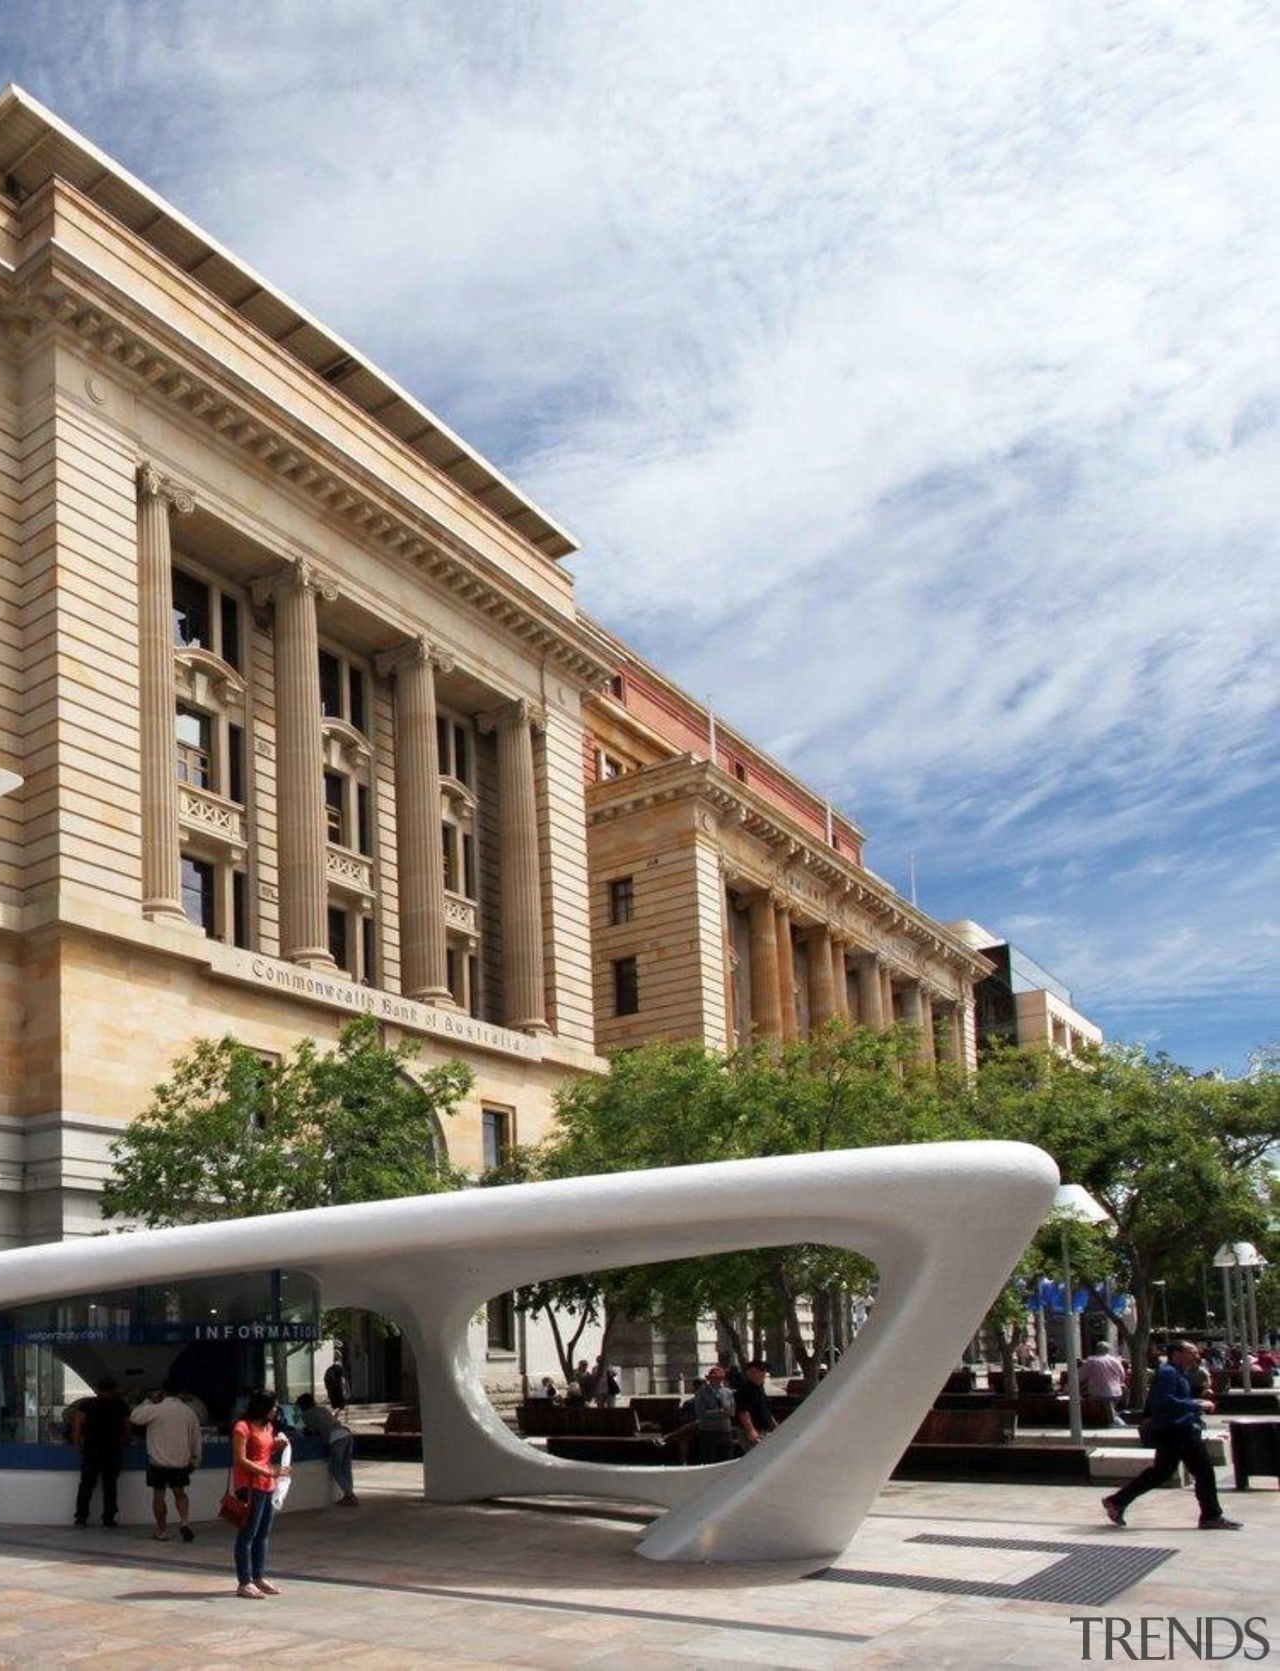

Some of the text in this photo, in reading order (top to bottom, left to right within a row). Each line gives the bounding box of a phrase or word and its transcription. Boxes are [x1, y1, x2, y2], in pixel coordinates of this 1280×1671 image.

[252, 958, 520, 1050] Commonwealth Bank of Australia
[195, 1325, 319, 1341] INFORMATION
